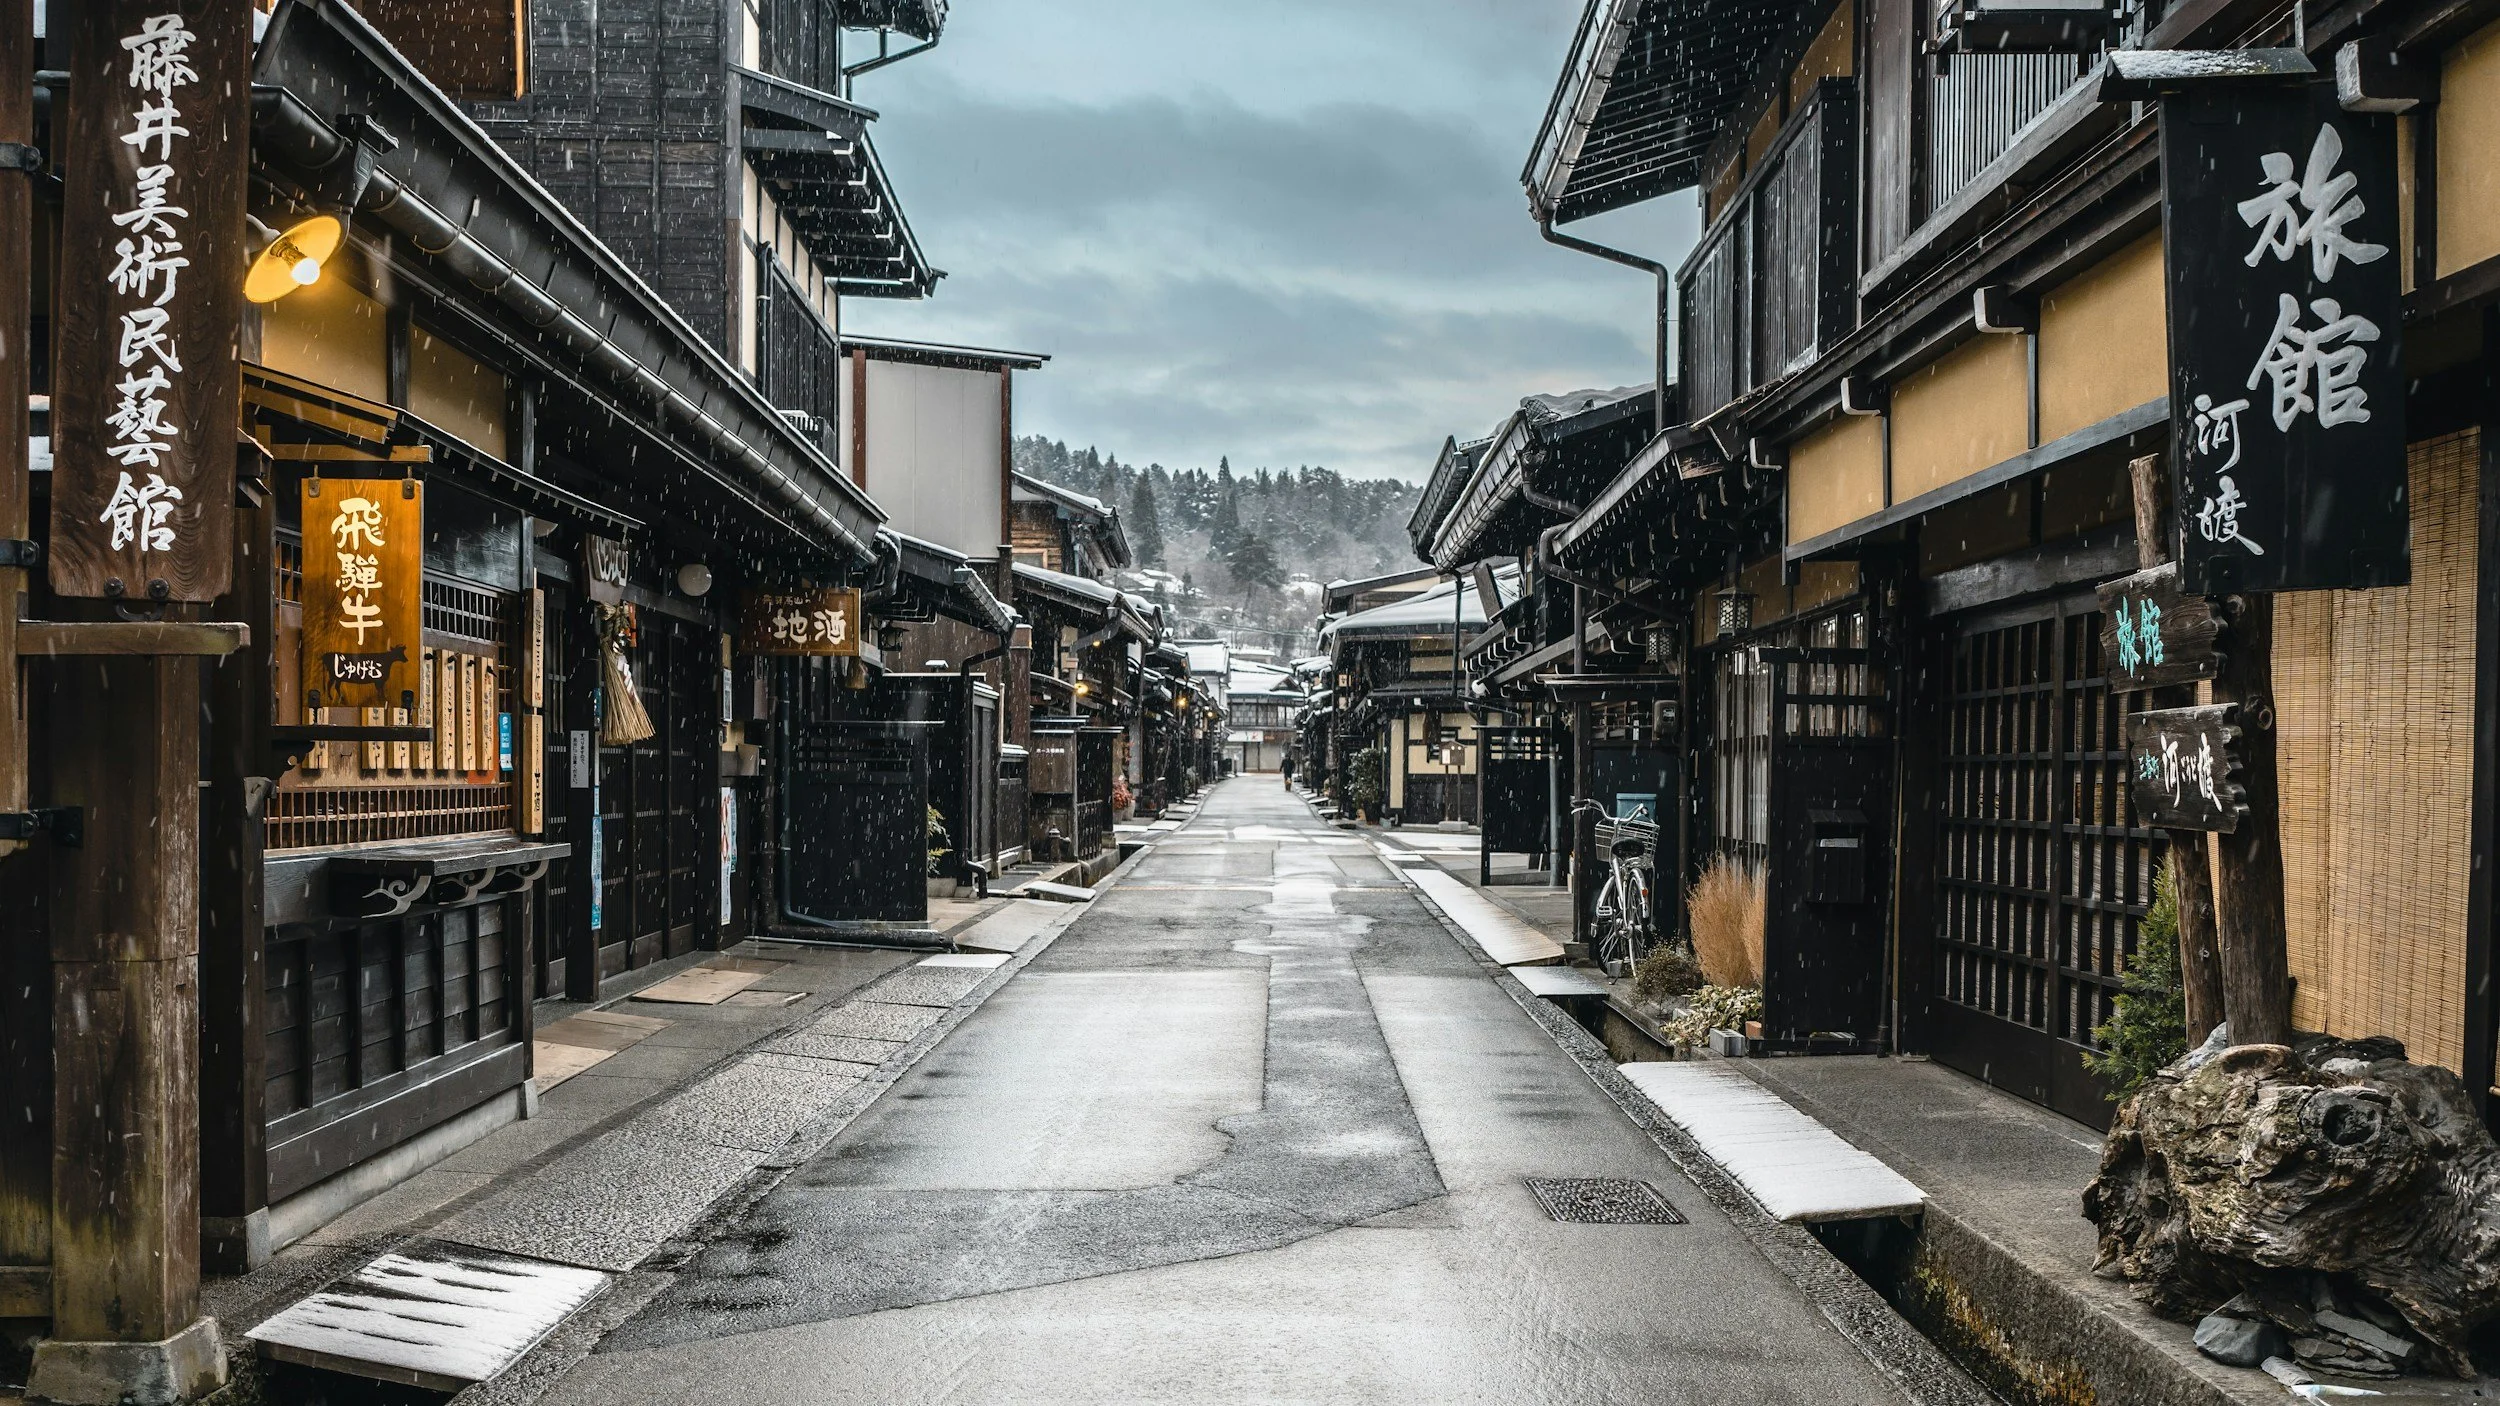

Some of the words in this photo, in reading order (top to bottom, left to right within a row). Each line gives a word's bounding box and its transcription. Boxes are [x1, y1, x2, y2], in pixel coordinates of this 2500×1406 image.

[100, 14, 198, 552] 藤井美術民藝館
[2236, 122, 2390, 433] 旅館
[2195, 394, 2265, 556] 河渡
[334, 653, 383, 680] じゅげむ
[772, 608, 847, 645] 地酒
[2115, 596, 2164, 679] 旅館
